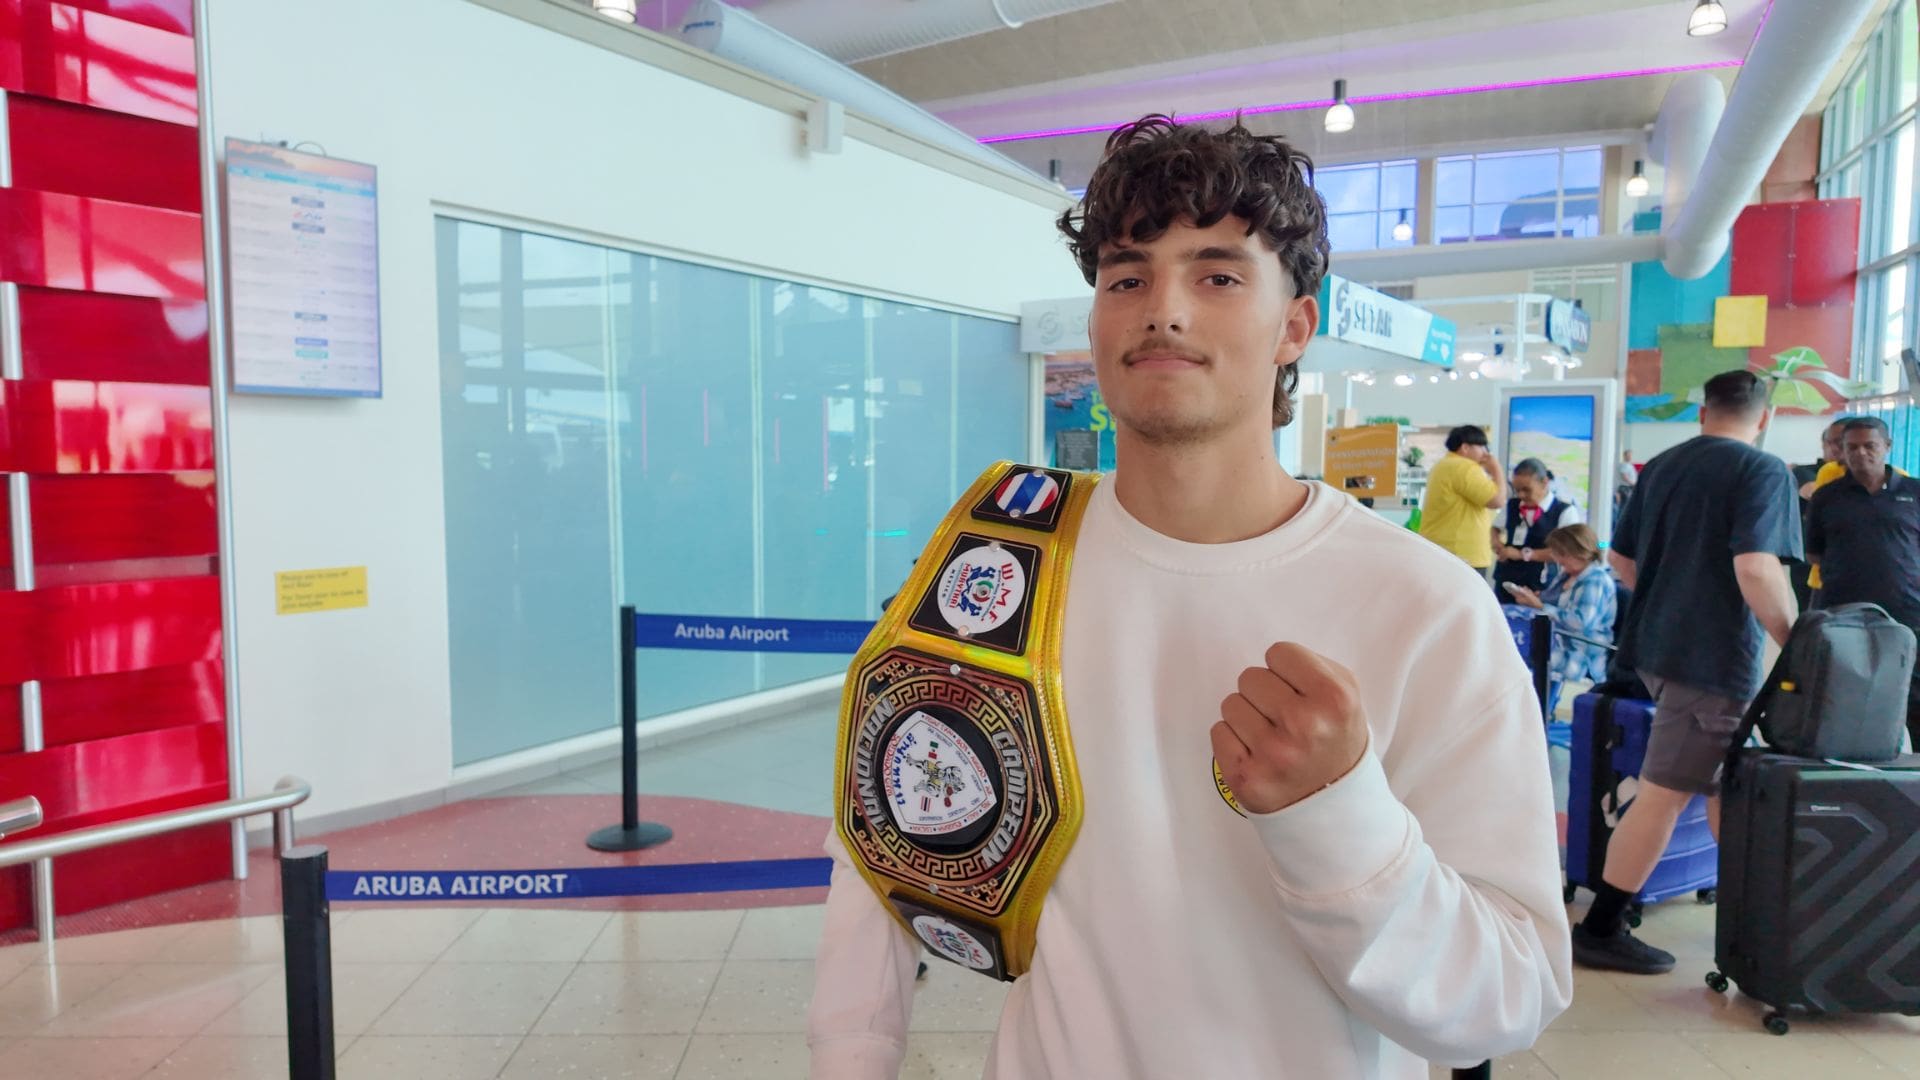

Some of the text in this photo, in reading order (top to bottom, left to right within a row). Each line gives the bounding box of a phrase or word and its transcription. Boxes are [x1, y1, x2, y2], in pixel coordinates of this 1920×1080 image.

[674, 622, 789, 643] Aruba Airport
[855, 696, 897, 833] NACIONAL
[982, 730, 1027, 868] CAMPEON
[353, 874, 568, 896] ARUBA AIRPORT
